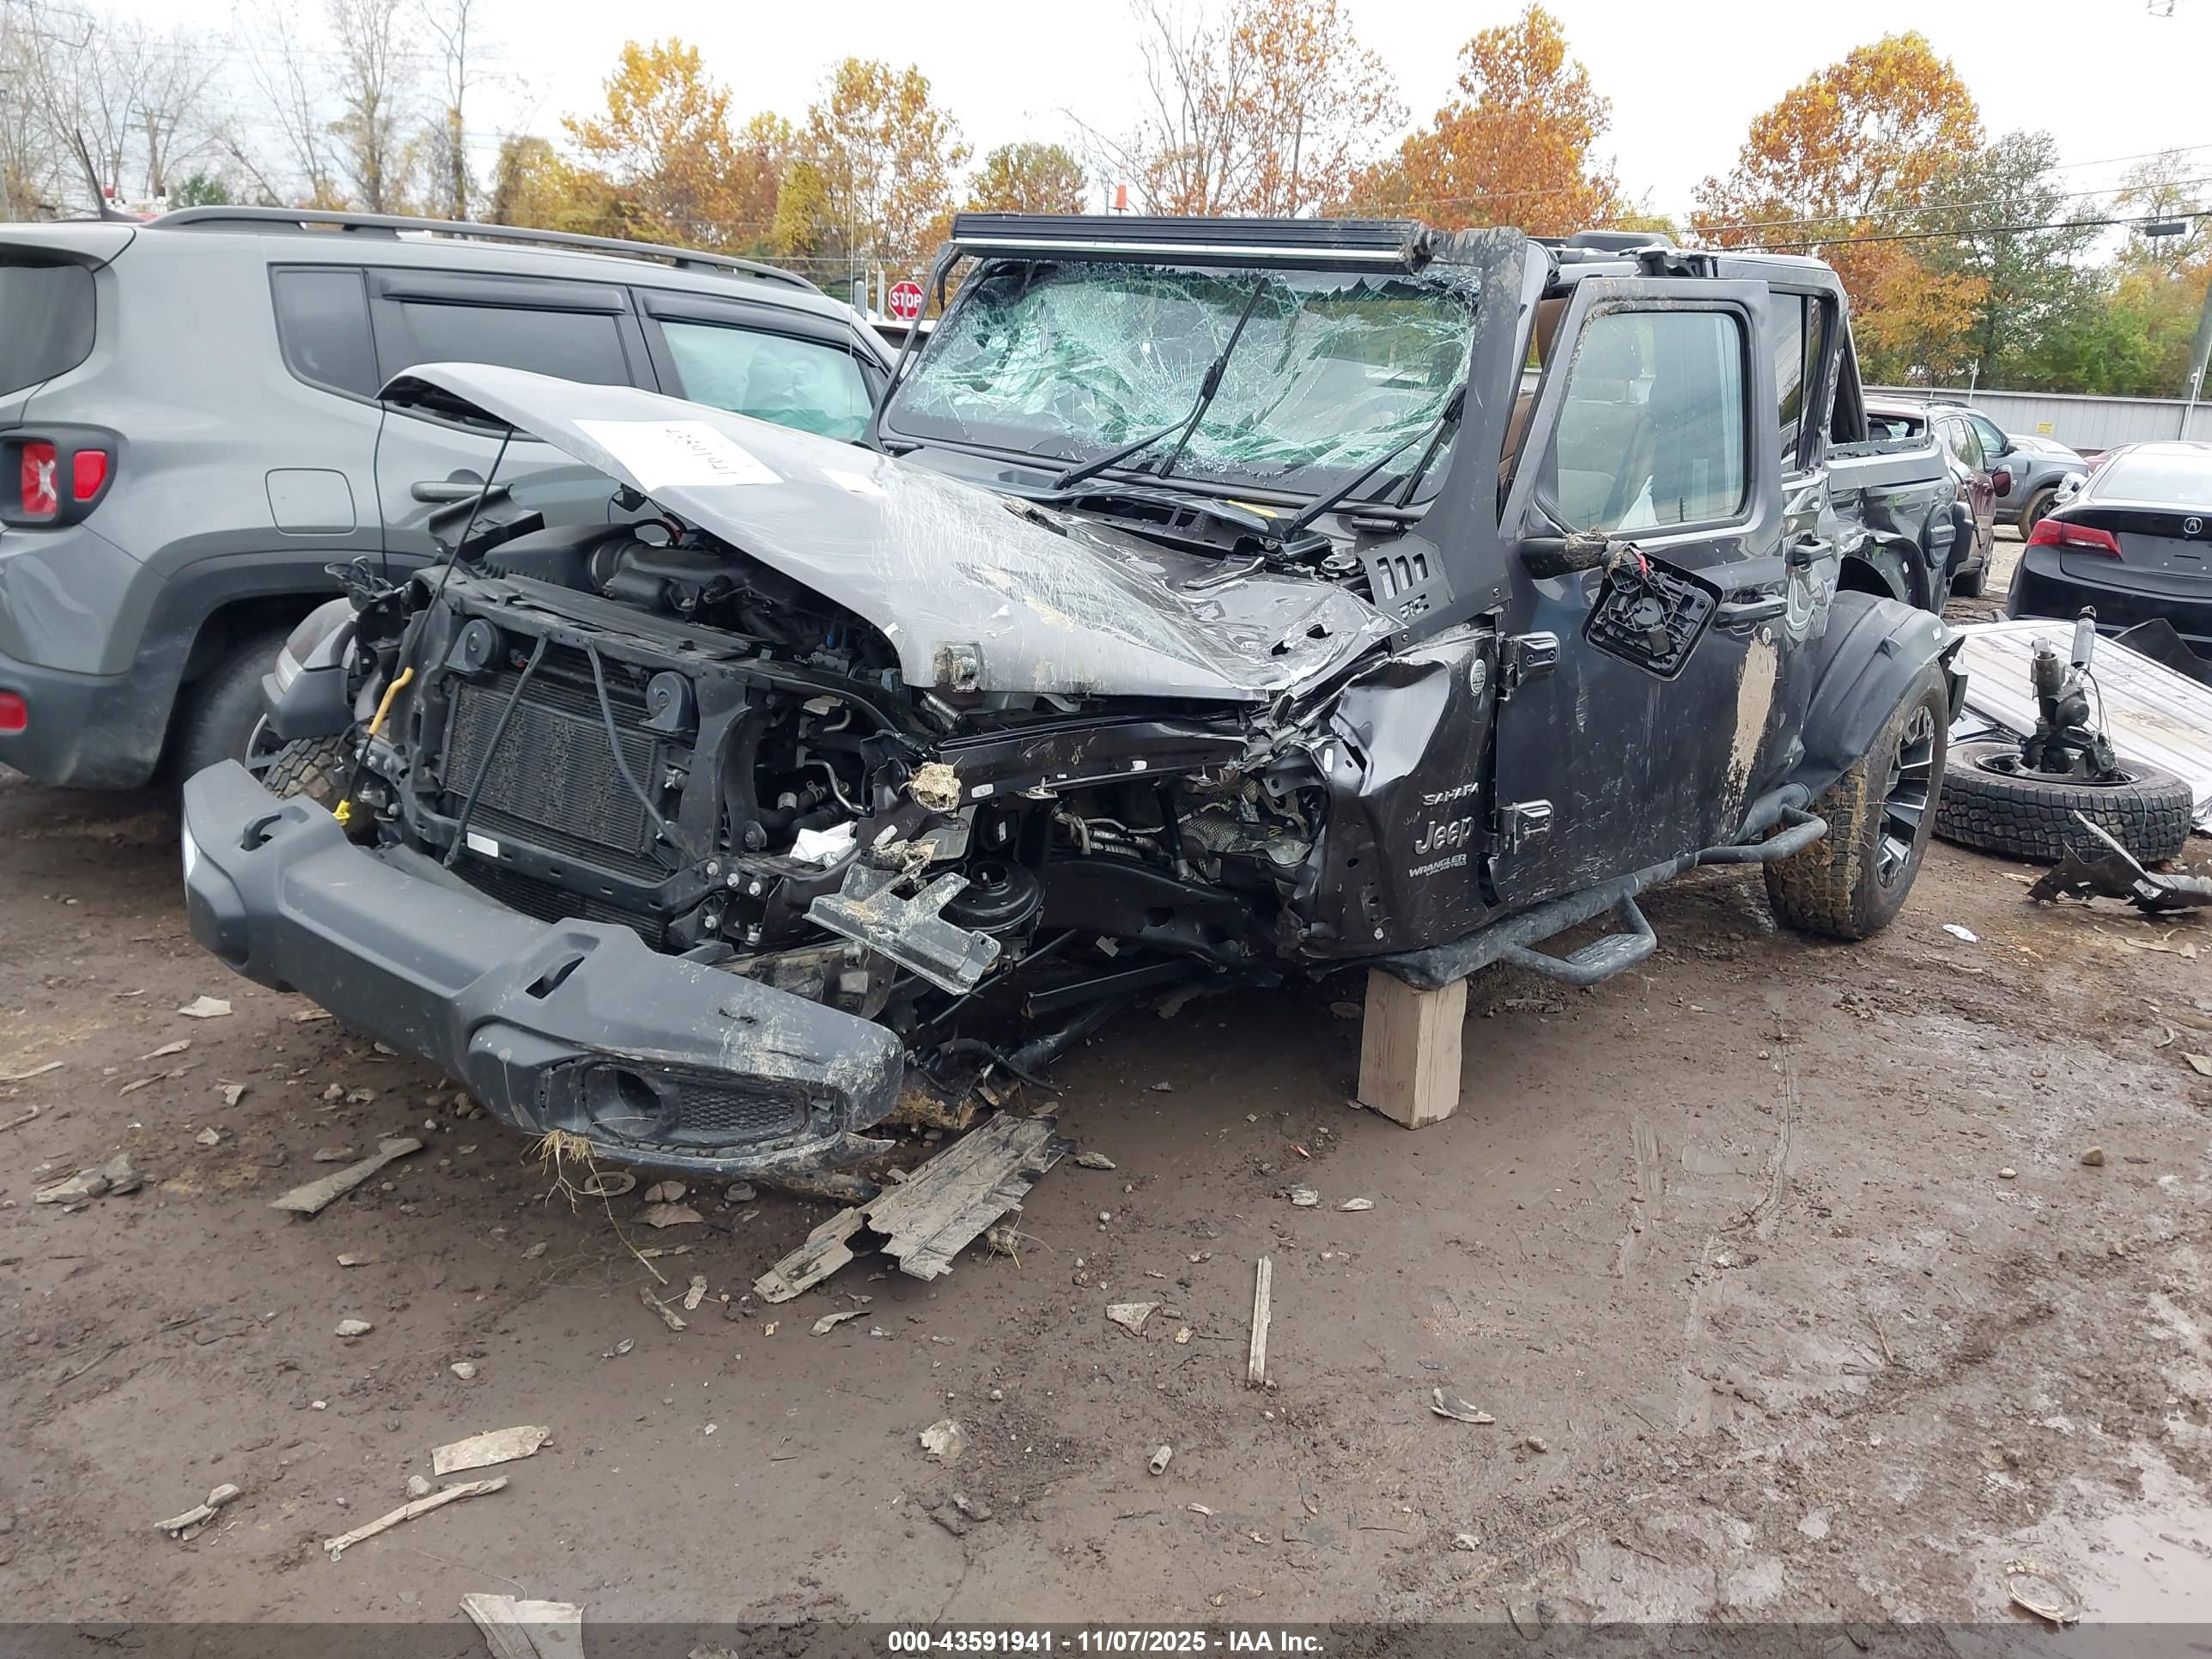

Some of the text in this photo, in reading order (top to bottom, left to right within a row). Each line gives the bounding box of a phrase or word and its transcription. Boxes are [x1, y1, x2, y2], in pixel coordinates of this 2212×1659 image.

[890, 291, 922, 308] STOP
[1422, 781, 1480, 806] SAHARA
[1414, 816, 1475, 855] Jeep
[1408, 853, 1468, 878] WRANGLER
[1425, 860, 1468, 877] UNLIMITED
